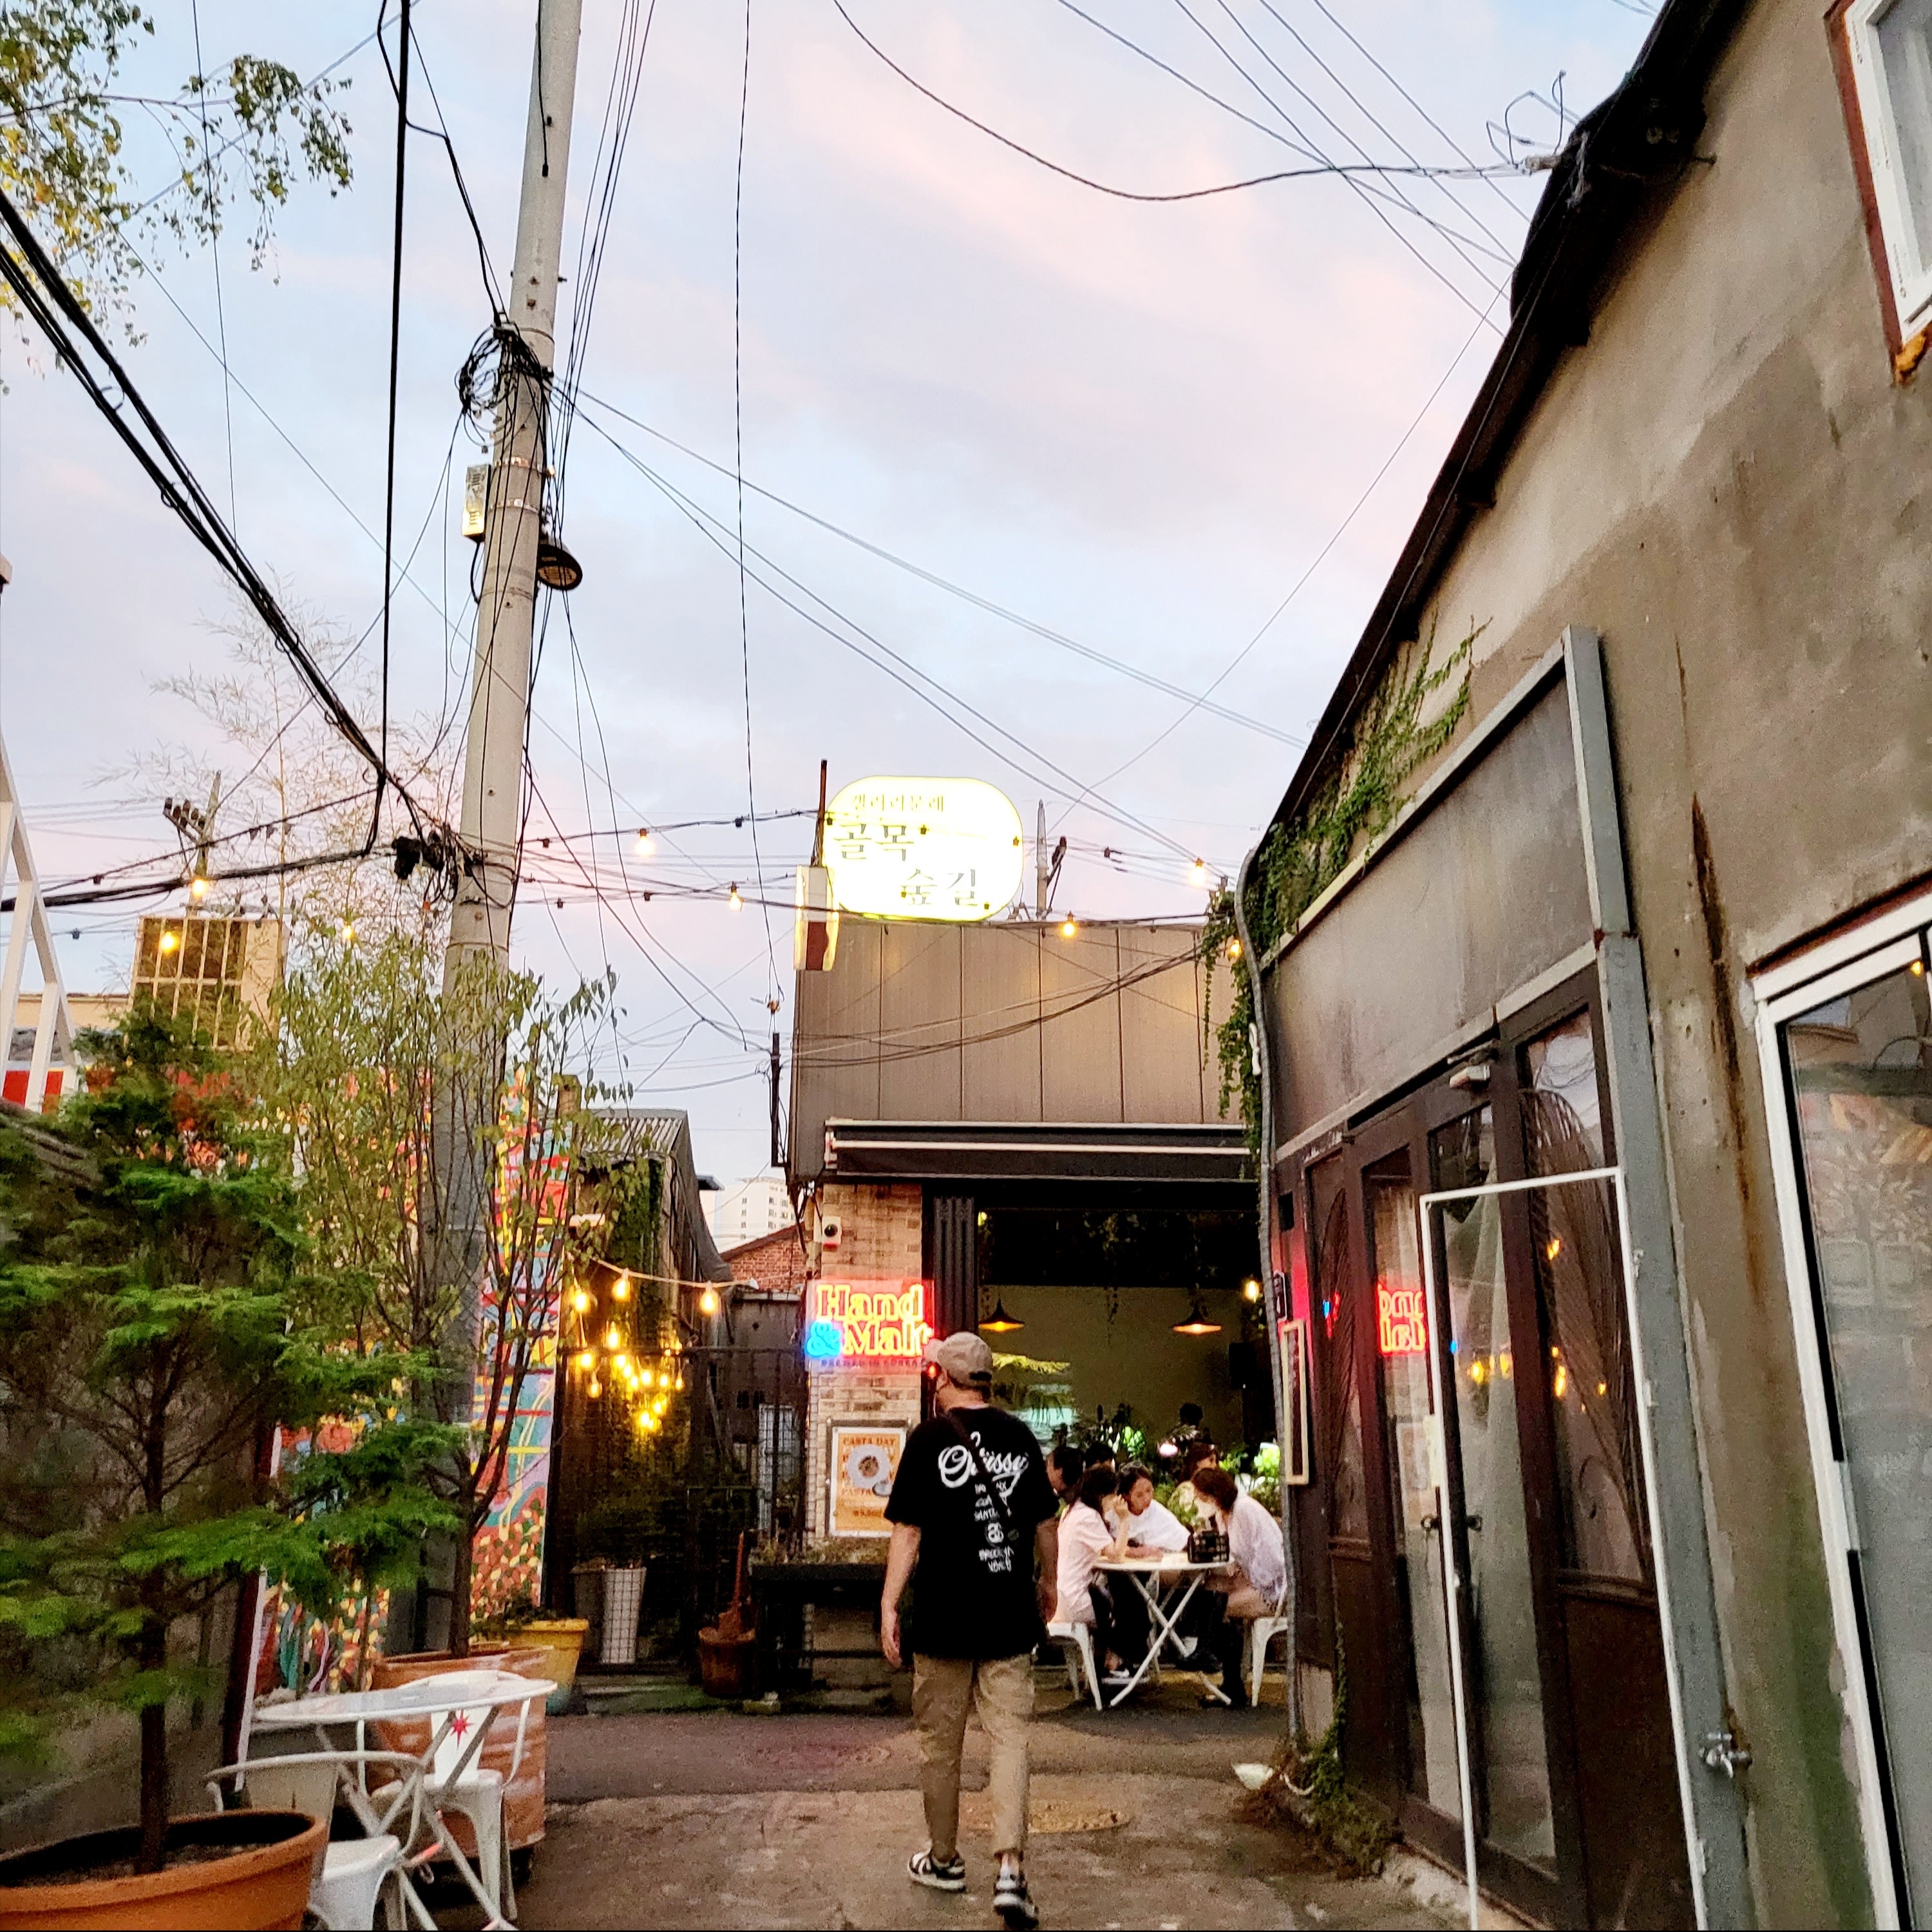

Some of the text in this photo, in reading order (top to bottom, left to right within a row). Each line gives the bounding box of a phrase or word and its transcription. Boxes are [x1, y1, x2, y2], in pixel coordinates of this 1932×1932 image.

[833, 823, 914, 862] 골목
[900, 868, 979, 905] 숲길
[815, 1283, 924, 1321] Hand
[806, 1320, 842, 1357] &
